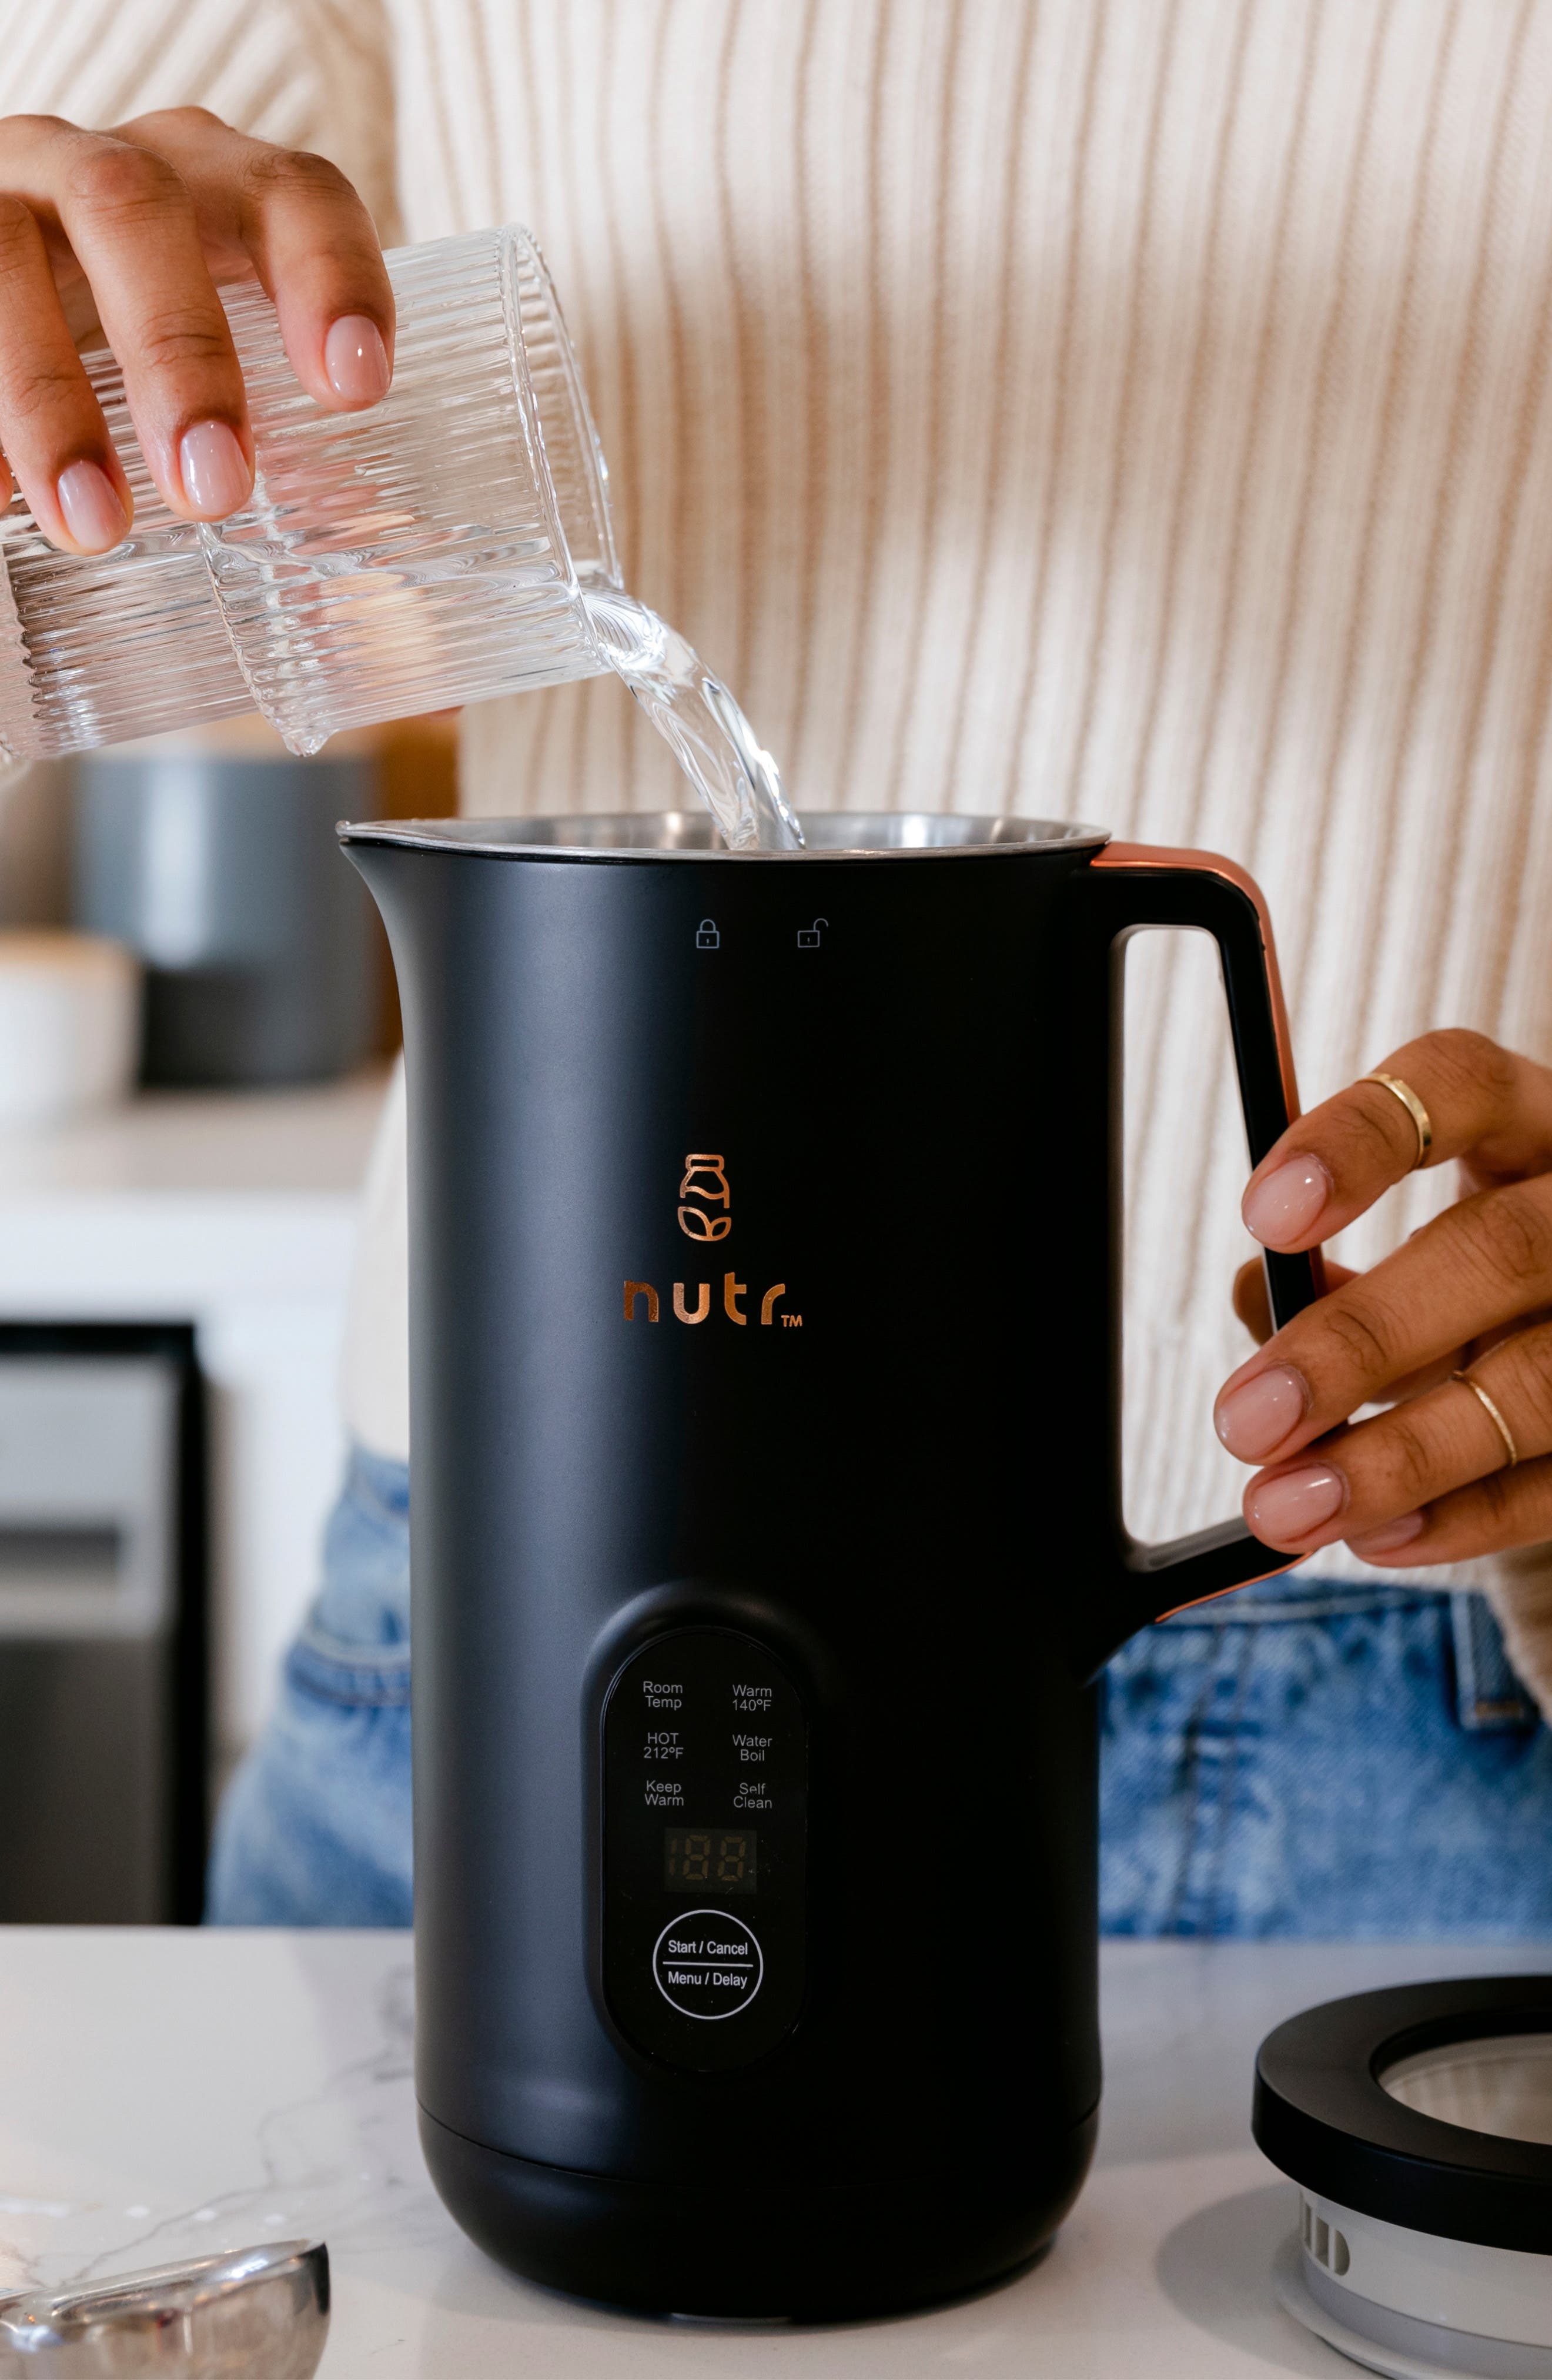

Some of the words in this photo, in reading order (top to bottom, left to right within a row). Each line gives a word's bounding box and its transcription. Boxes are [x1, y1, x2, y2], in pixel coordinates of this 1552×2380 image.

[643, 1680, 683, 1694] Room
[732, 1684, 772, 1697] Warm
[645, 1695, 682, 1711] Temp
[732, 1699, 772, 1712] 140°F
[647, 1732, 679, 1744] HOT
[732, 1734, 772, 1747] Water
[644, 1746, 684, 1759] 212°F
[740, 1749, 765, 1761] Boil
[646, 1780, 681, 1795] Keep
[739, 1782, 766, 1795] Self
[644, 1793, 684, 1806] Warm
[733, 1796, 772, 1809] Clean
[668, 1940, 697, 1954] Start
[707, 1941, 748, 1955] Cancel
[668, 1971, 702, 1985] Menu
[713, 1972, 748, 1990] Delay
